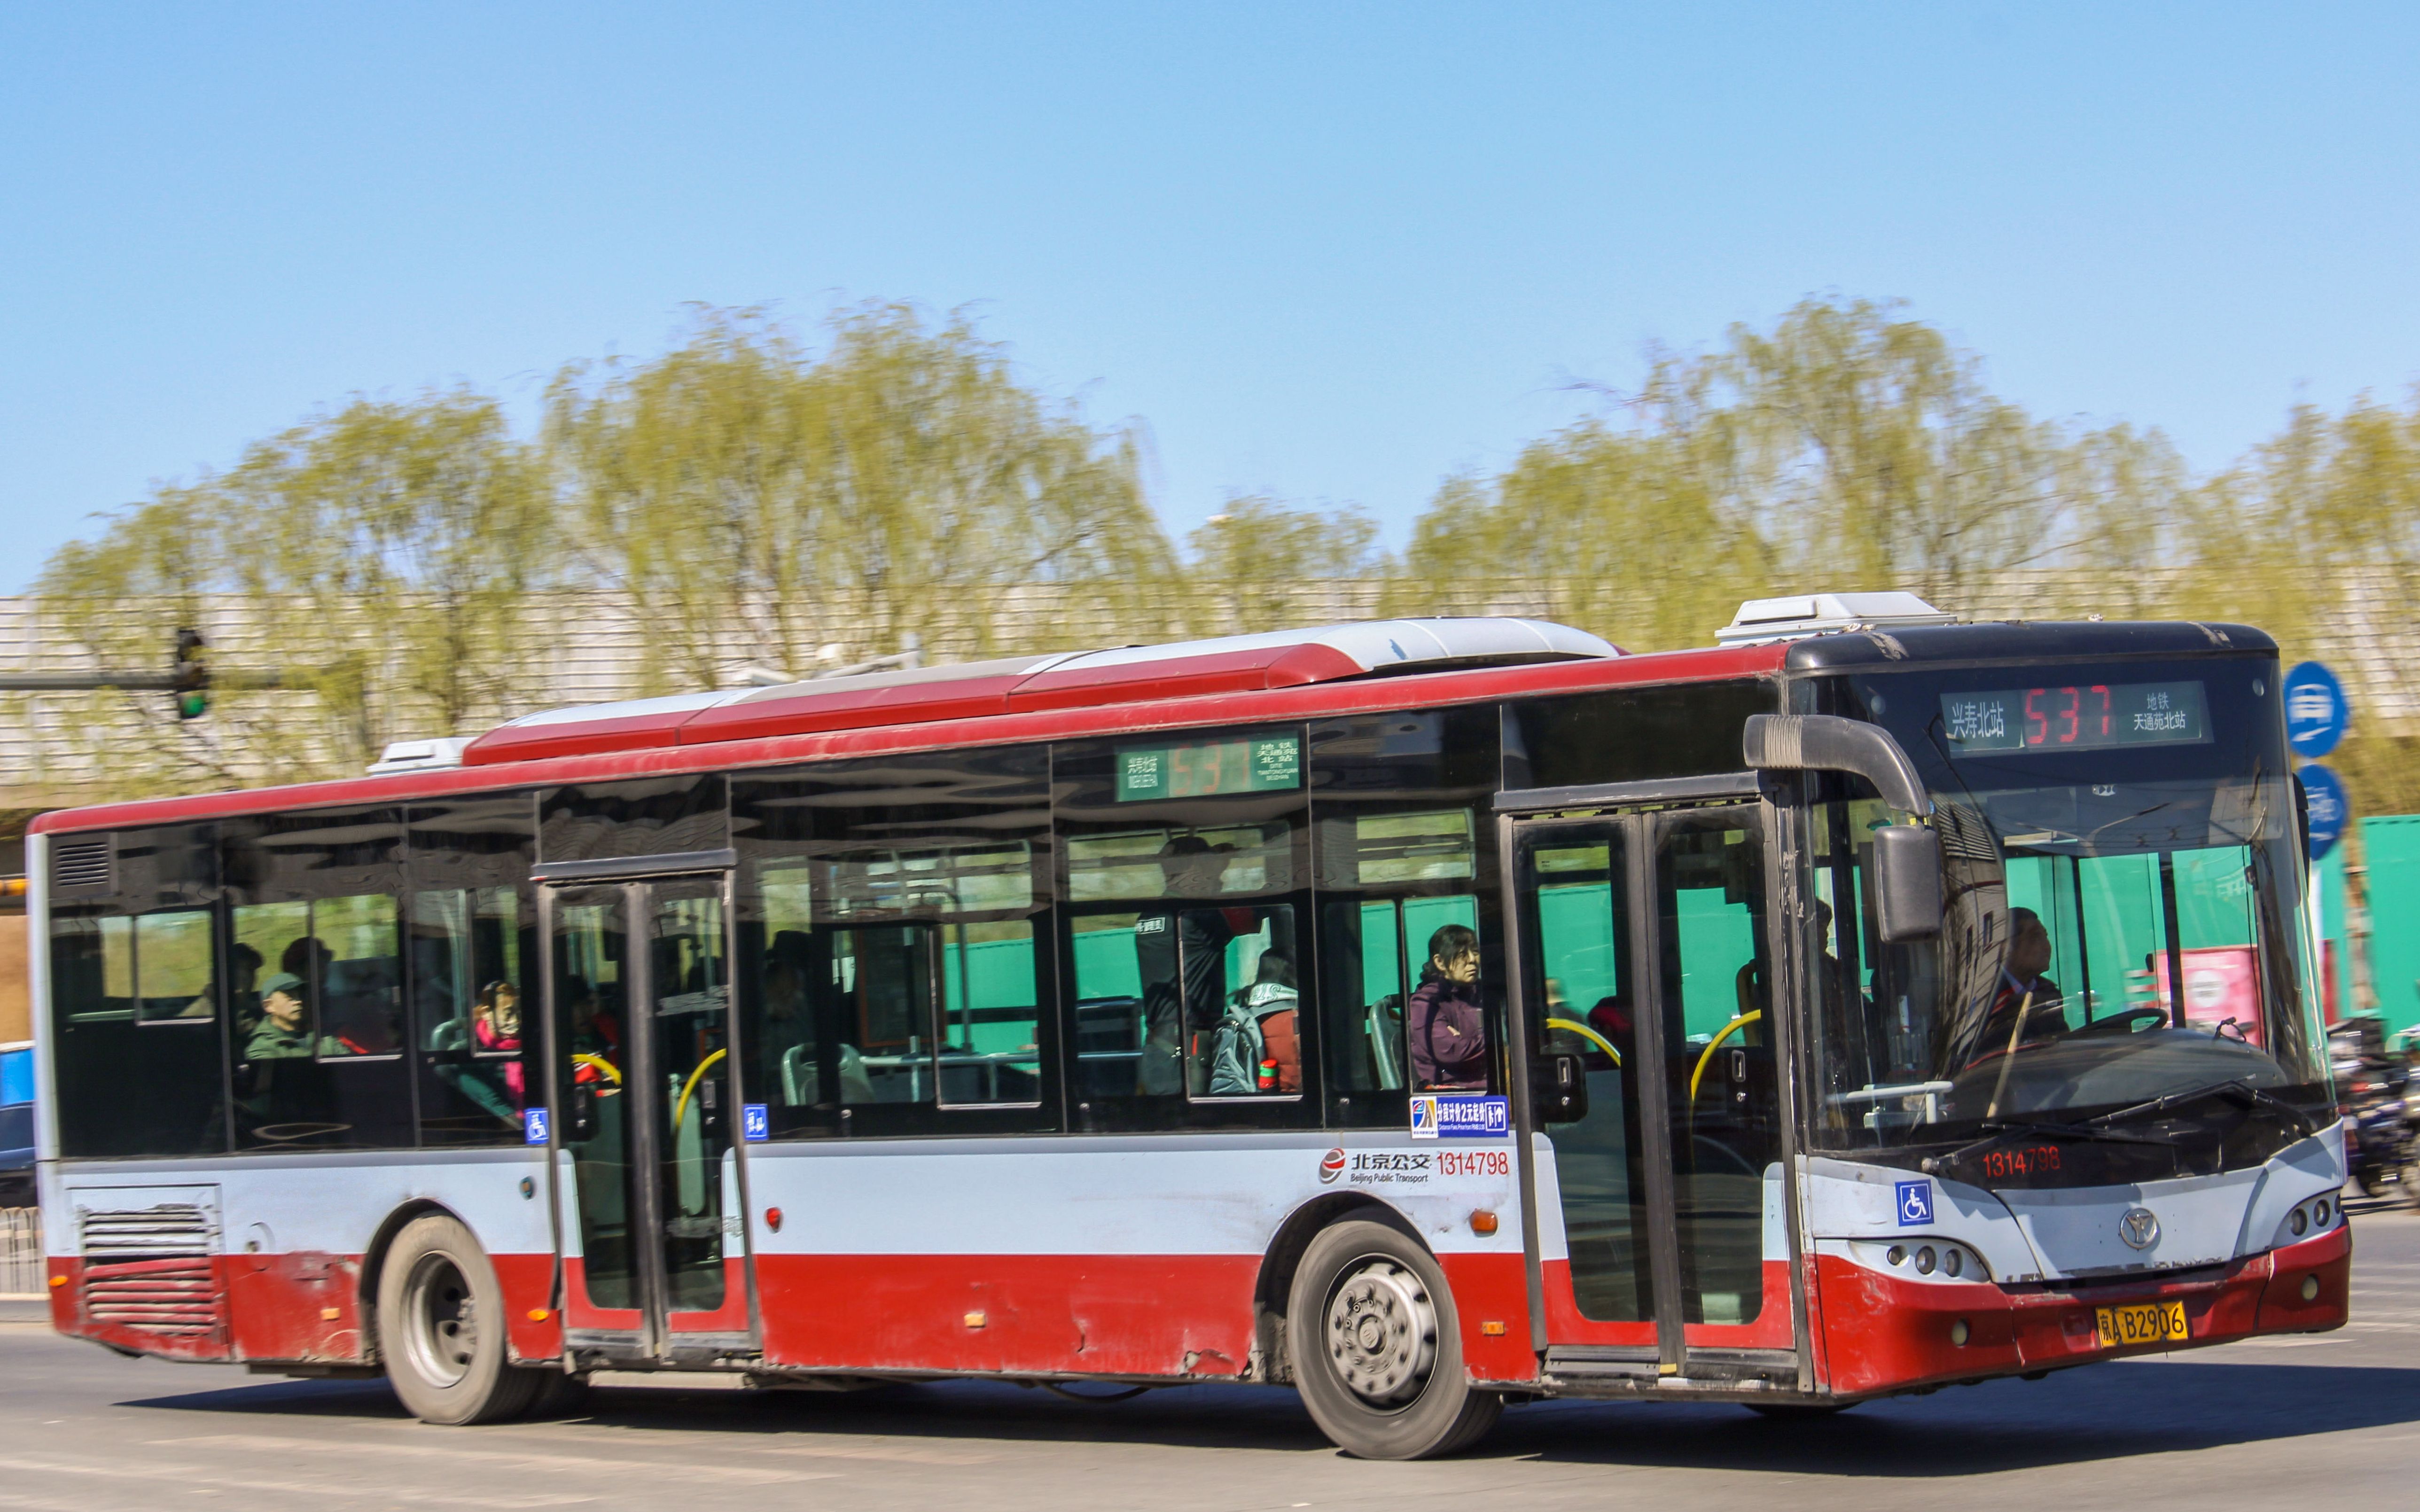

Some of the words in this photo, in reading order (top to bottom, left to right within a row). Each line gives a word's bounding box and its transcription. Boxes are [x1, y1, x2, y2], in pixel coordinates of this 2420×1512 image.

[2147, 692, 2169, 710] 地铁
[1952, 701, 2004, 739] 兴寿北站
[2025, 685, 2111, 744] 537
[2133, 711, 2186, 731] 天通苑北站
[1351, 1153, 1431, 1170] 北京公交
[1437, 1151, 1509, 1176] 1314798
[1982, 1146, 2061, 1178] 1314798
[1350, 1173, 1373, 1185] Beijing
[1374, 1173, 1395, 1183] Public
[1395, 1173, 1429, 1184] Transport
